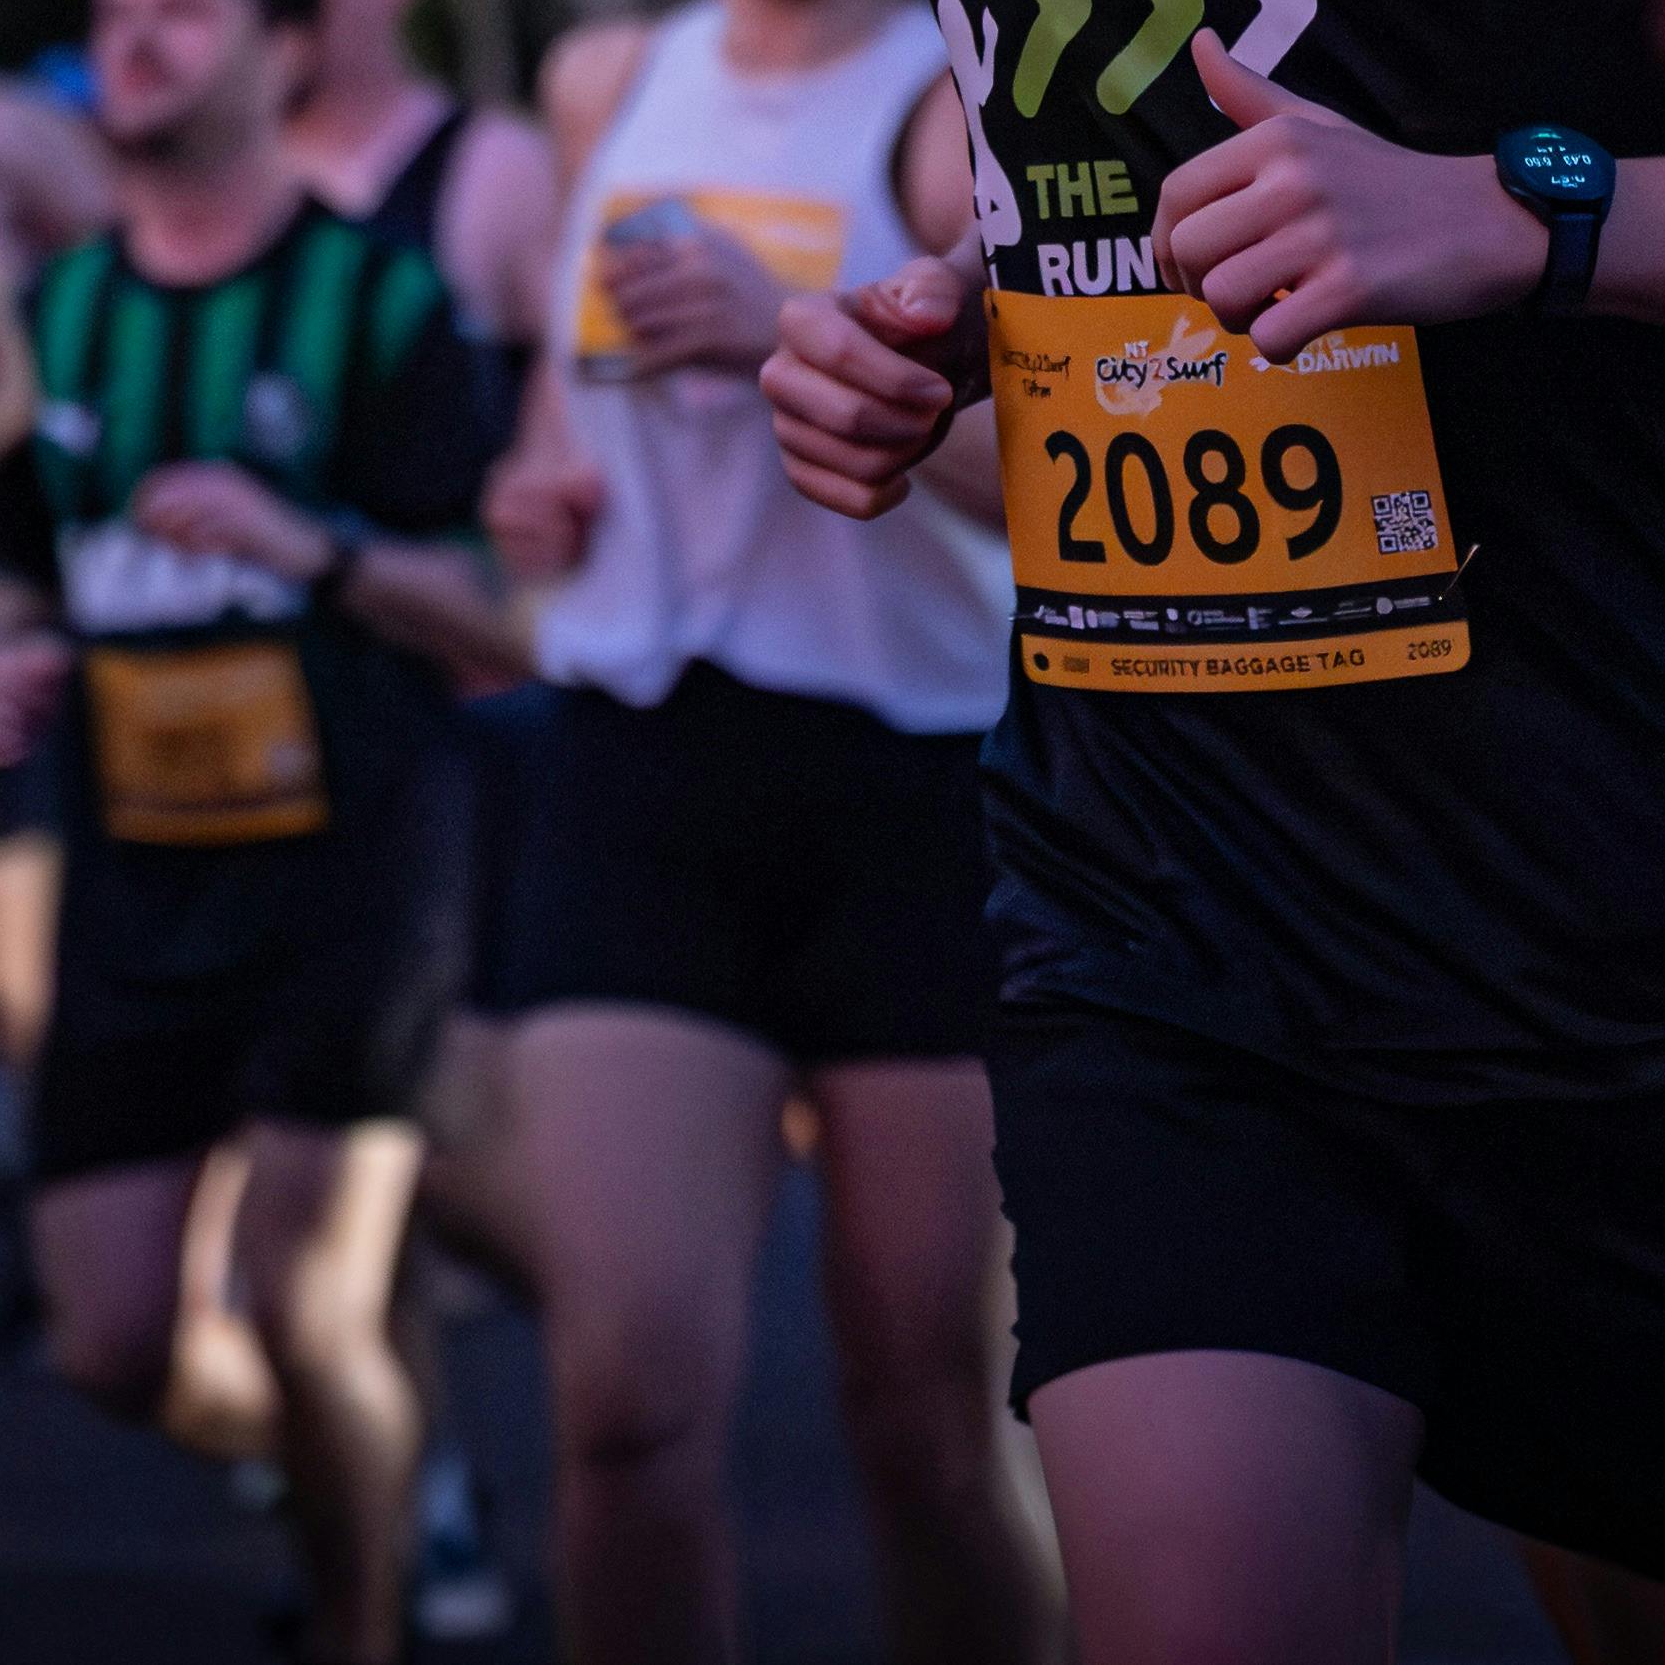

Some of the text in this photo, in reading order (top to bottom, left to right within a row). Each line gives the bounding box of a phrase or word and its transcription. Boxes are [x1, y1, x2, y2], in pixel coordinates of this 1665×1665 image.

[1026, 160, 1138, 219] THE
[1037, 236, 1157, 296] RUN
[1296, 342, 1400, 375] DARWIN
[1044, 424, 1343, 566] 2089
[1111, 657, 1200, 677] SECURITY
[1205, 653, 1311, 676] BAGGAGE
[1316, 649, 1365, 671] TAG
[1406, 639, 1453, 661] 2089
